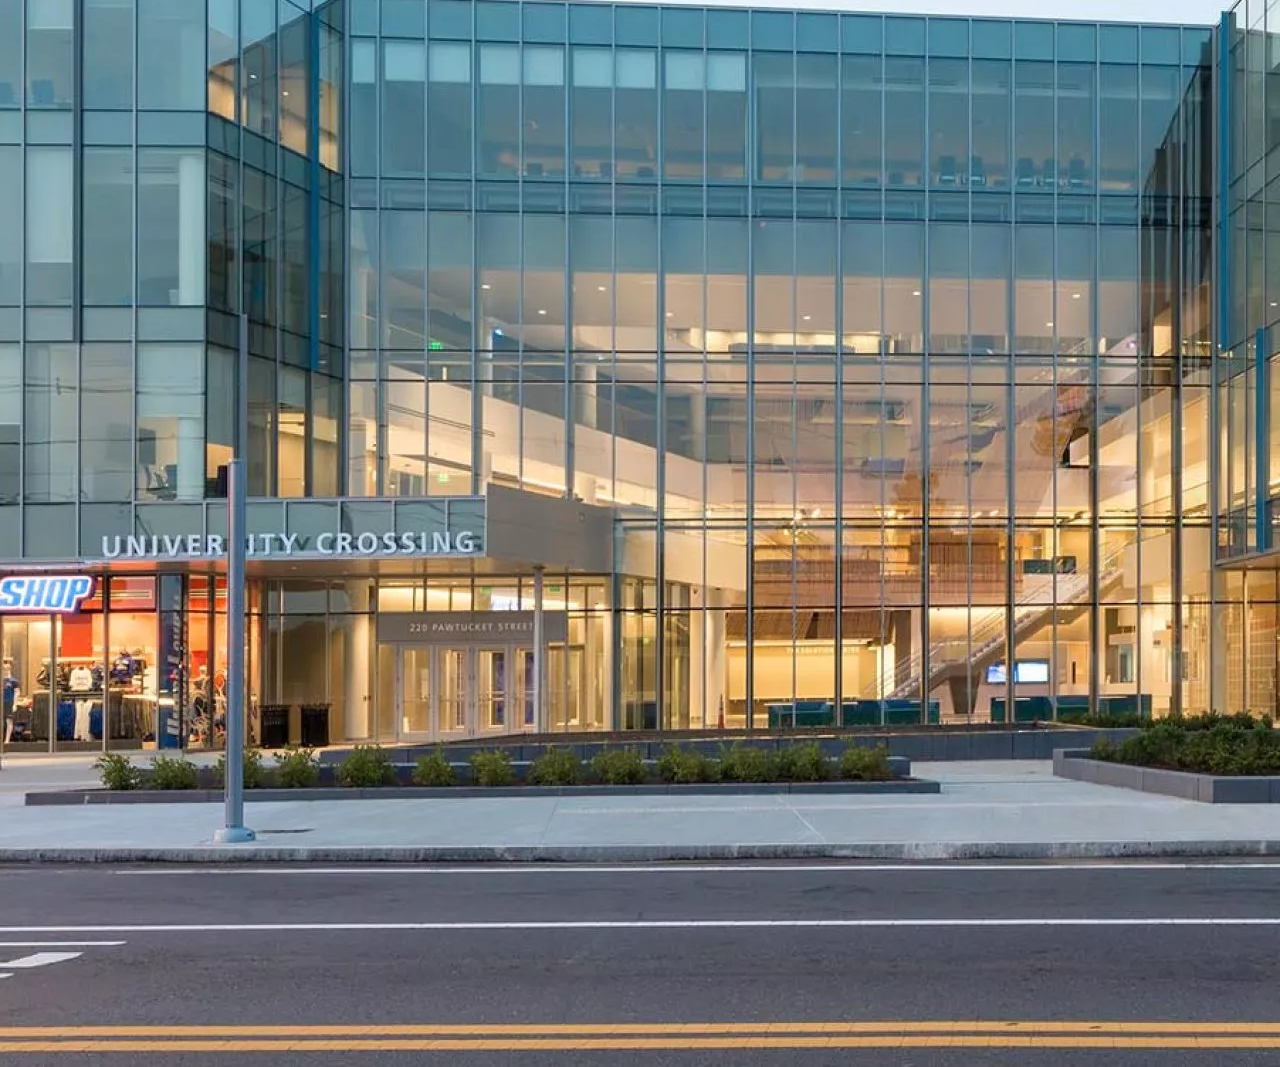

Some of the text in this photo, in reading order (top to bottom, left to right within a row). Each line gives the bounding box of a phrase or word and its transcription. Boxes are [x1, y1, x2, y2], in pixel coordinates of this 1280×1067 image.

[102, 530, 475, 558] UNIVERITY CROSSING
[0, 577, 90, 610] SHOP
[409, 622, 533, 632] 220 PAWTUCKET STREET
